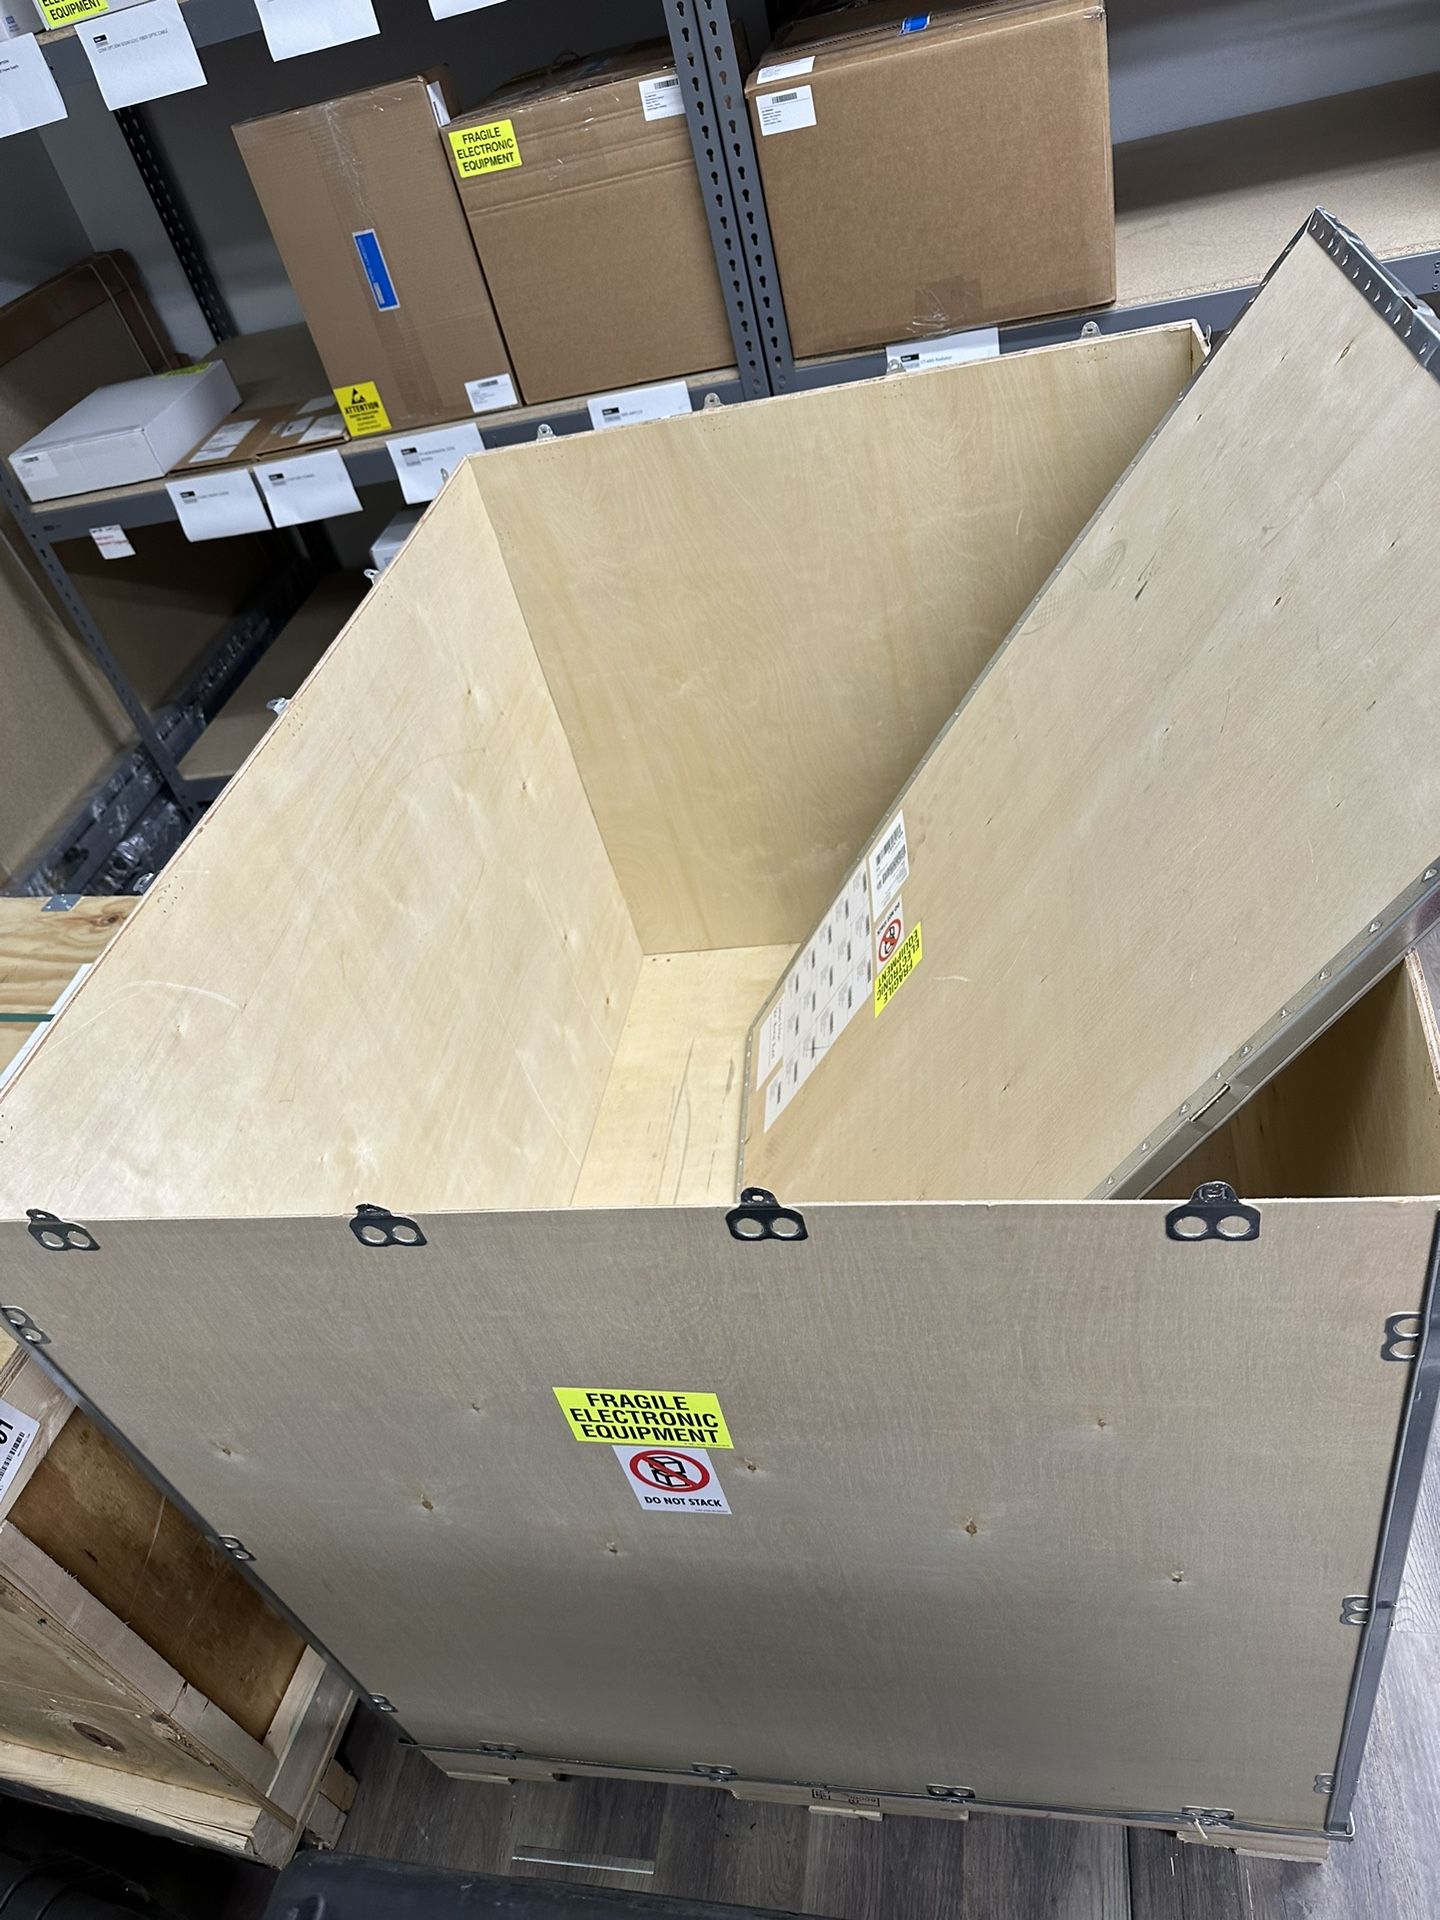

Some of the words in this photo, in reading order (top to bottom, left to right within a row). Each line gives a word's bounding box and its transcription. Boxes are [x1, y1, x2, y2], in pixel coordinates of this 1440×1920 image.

[49, 0, 101, 21] EQUIPMENT
[462, 127, 501, 144] FRAGILE
[457, 138, 515, 160] ELECTRONIC
[462, 152, 515, 172] EQUIPMENT
[344, 402, 379, 414] ATTENTION
[877, 929, 918, 989] EQUIPMENT
[876, 939, 920, 1001] ELECTRONIC
[883, 960, 913, 1004] FRAGILE
[585, 1392, 690, 1411] FRAGILE
[569, 1408, 719, 1428] ELECTRONIC
[581, 1424, 718, 1444] EQUIPMENT
[644, 1496, 661, 1505] DO
[665, 1497, 686, 1506] NOT
[689, 1498, 723, 1507] STACK
